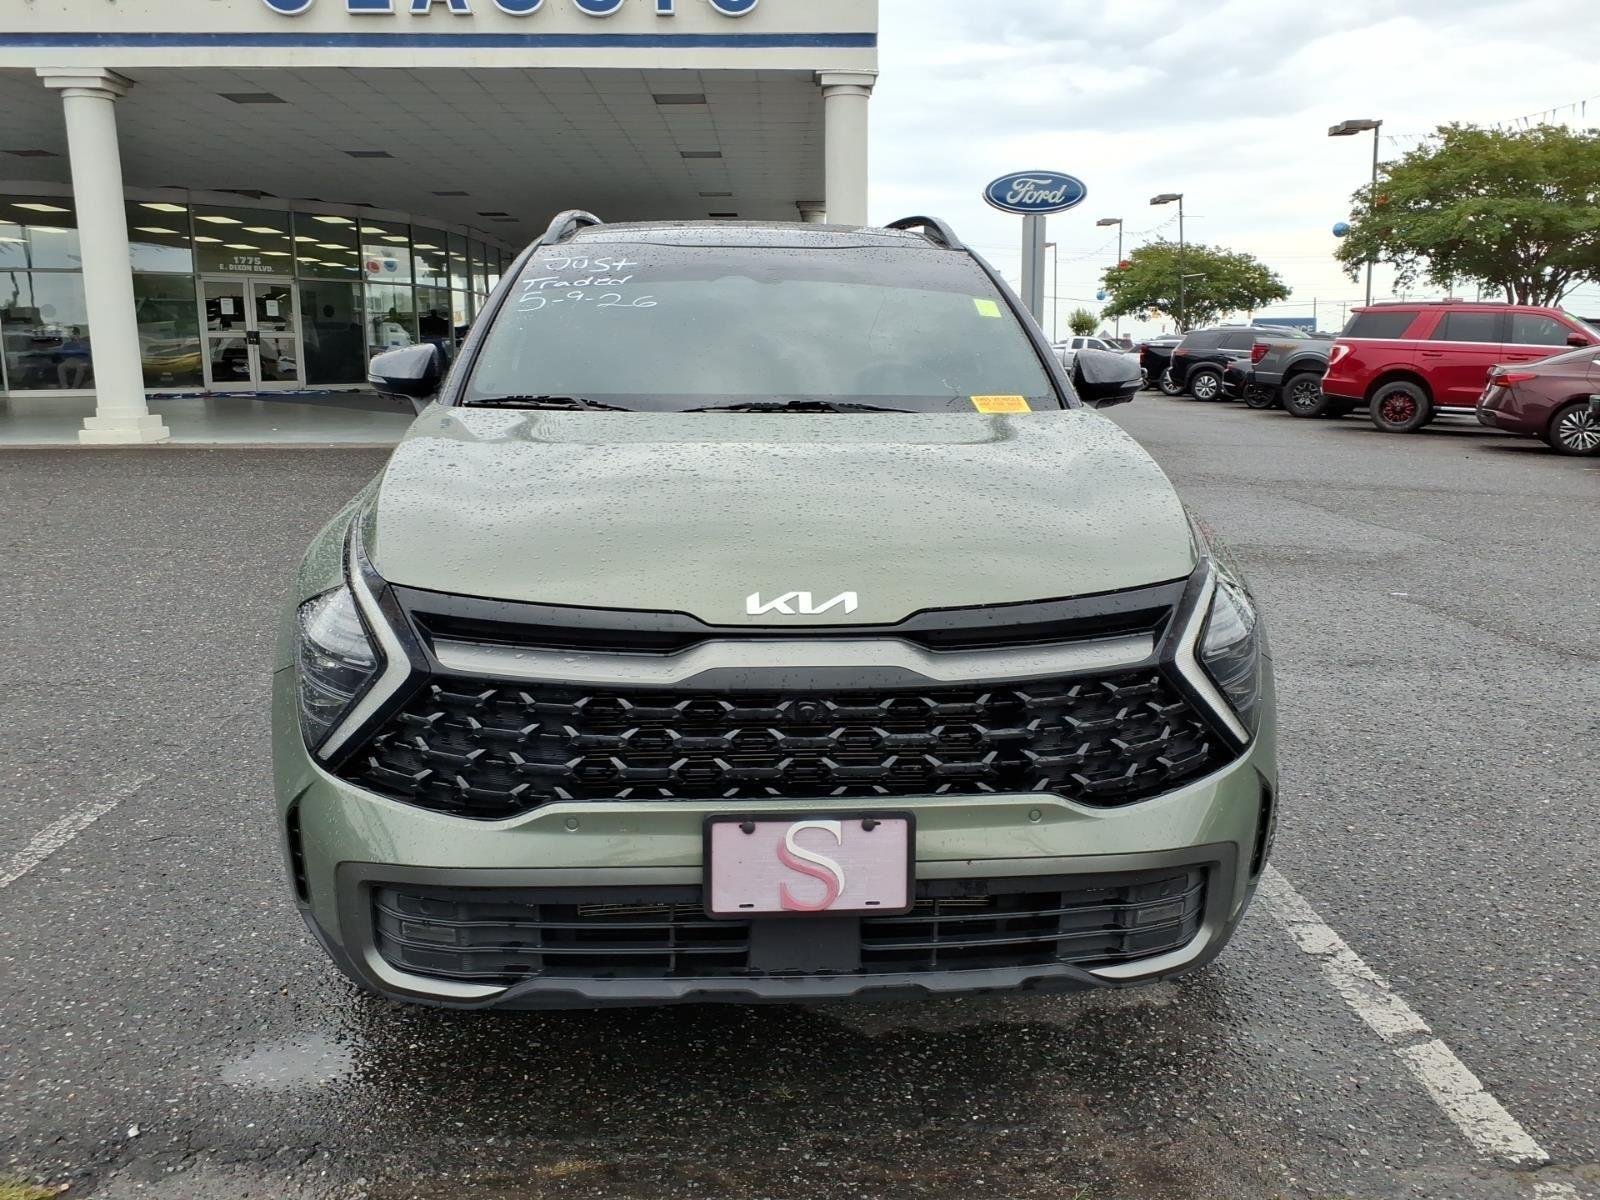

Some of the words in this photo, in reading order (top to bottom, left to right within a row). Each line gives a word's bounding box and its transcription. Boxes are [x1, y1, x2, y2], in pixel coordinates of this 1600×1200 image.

[1006, 178, 1067, 204] Ford
[233, 256, 262, 265] 1775
[522, 274, 633, 291] Traded
[516, 290, 657, 312] 5-9-26
[746, 591, 858, 615] KIA
[777, 820, 845, 912] S
